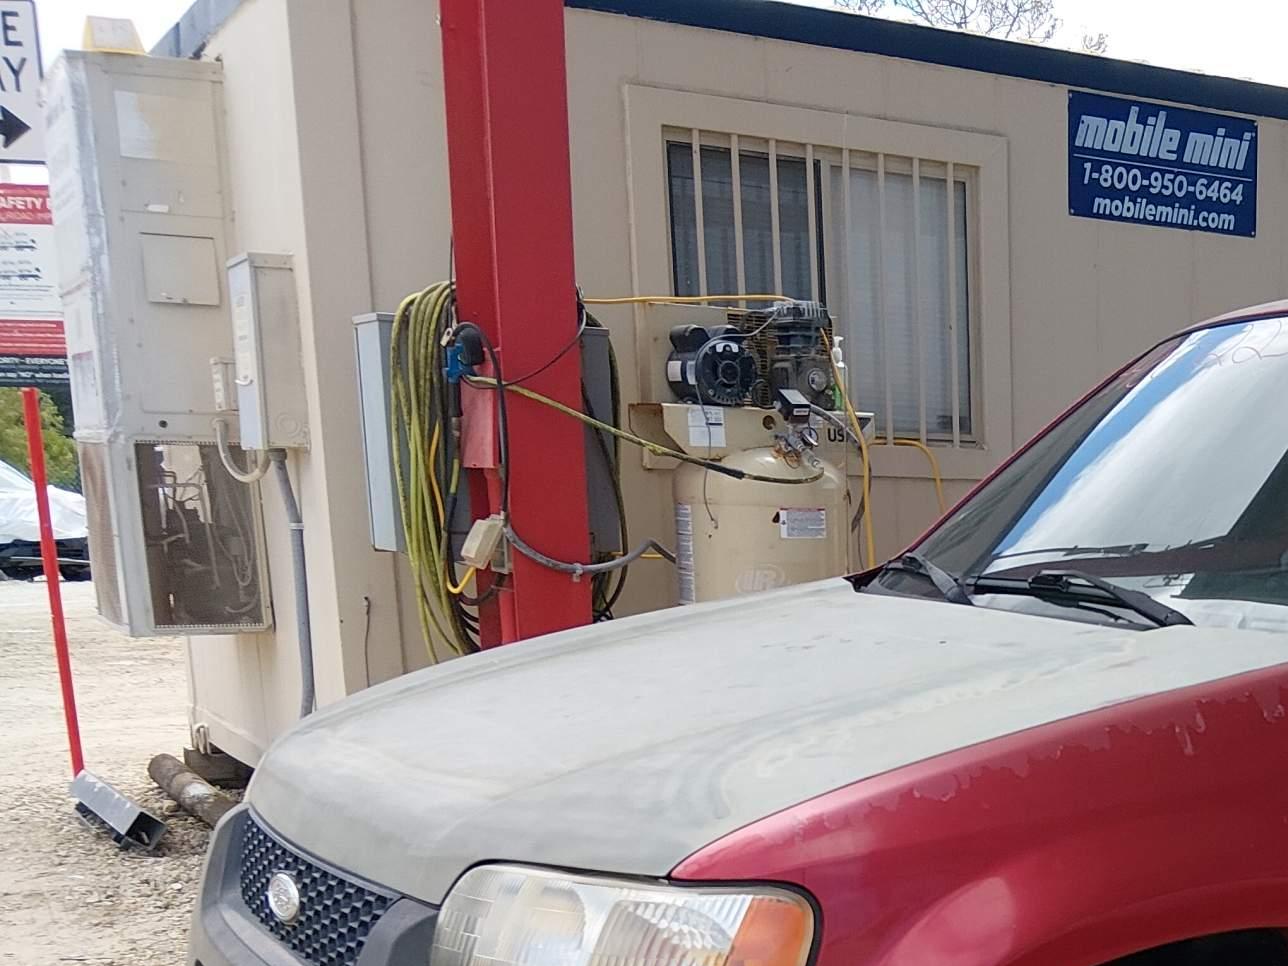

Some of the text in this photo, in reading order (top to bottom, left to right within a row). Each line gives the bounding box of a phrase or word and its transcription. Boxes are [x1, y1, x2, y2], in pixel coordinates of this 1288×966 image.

[1074, 105, 1252, 171] mobile mini
[1083, 162, 1244, 205] 1-800-950-6464
[1092, 195, 1236, 231] mobilemini.com
[827, 428, 850, 443] US
